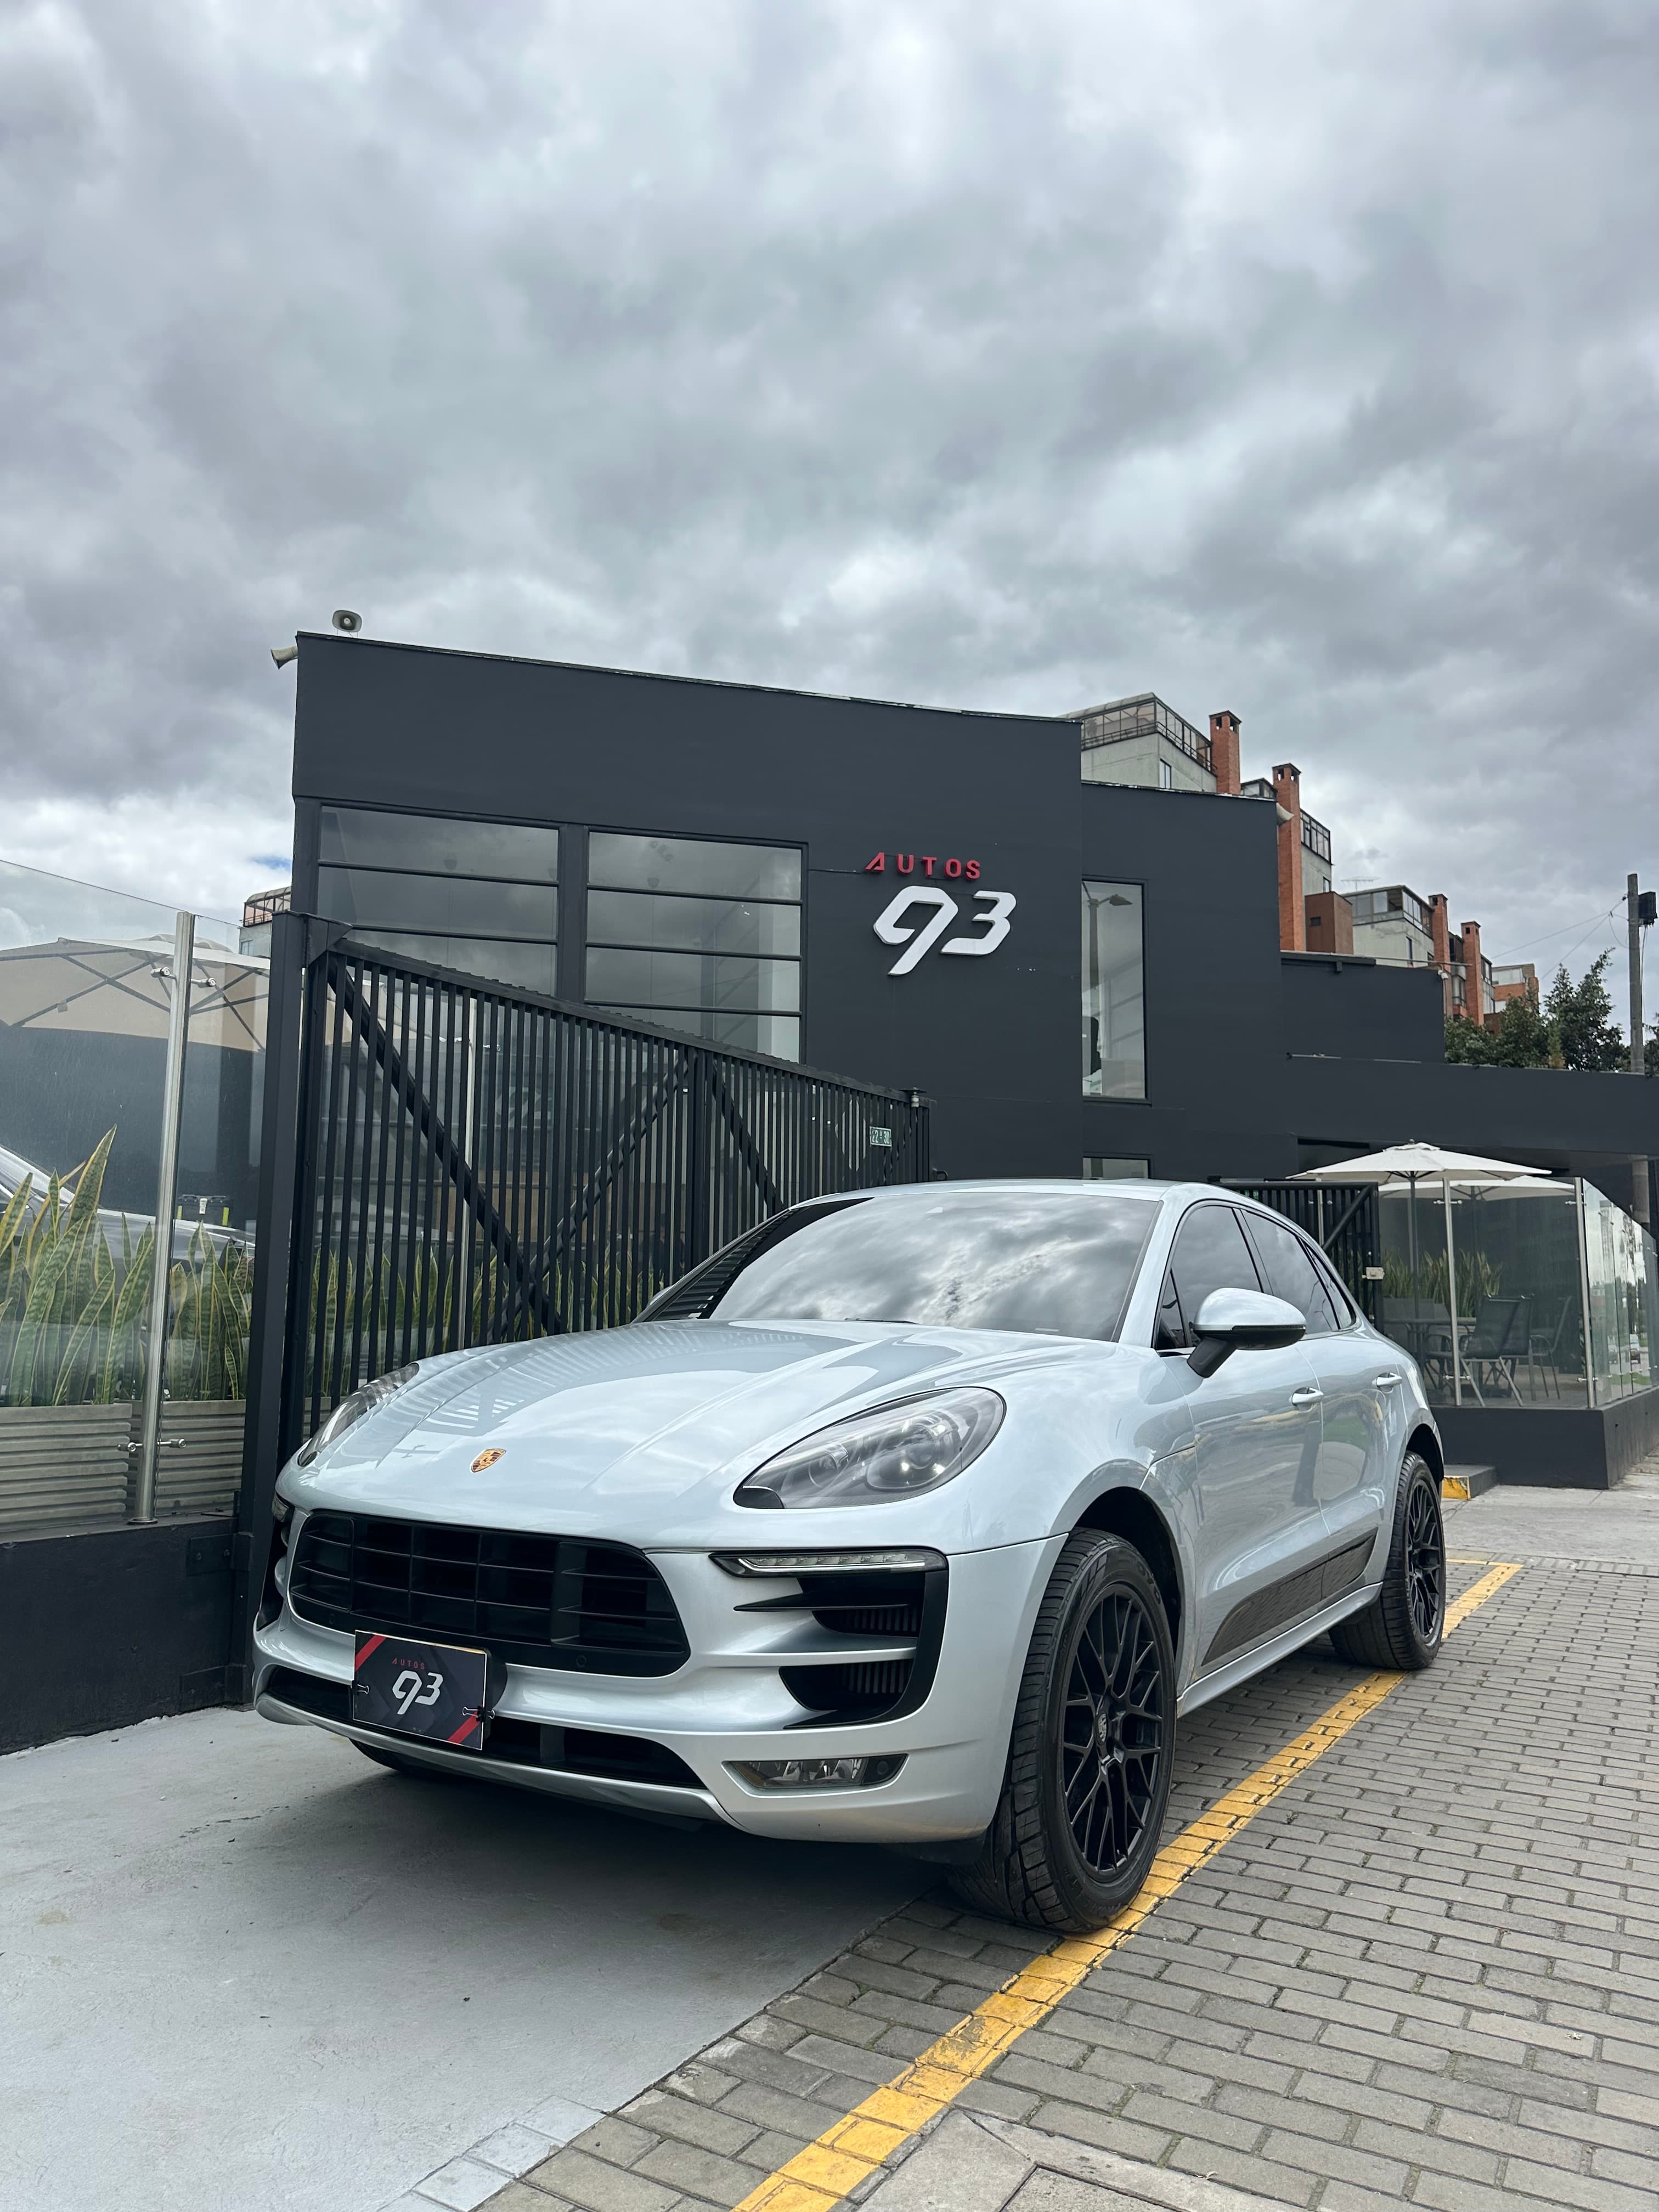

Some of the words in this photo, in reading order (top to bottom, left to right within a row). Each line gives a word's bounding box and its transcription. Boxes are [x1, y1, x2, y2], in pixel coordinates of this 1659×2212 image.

[865, 851, 981, 881] AUTOS
[873, 885, 1017, 976] 93
[391, 1657, 426, 1670] AUTOS
[392, 1669, 444, 1716] 93
